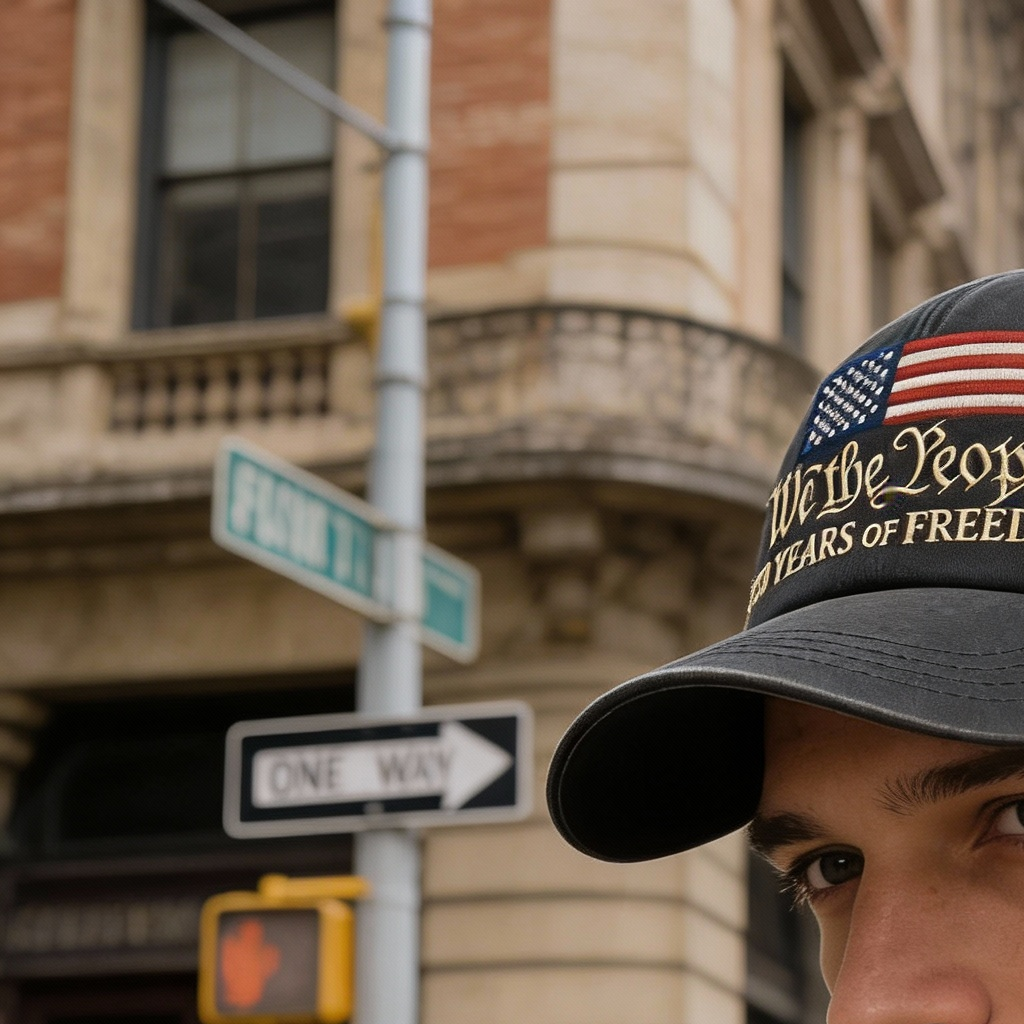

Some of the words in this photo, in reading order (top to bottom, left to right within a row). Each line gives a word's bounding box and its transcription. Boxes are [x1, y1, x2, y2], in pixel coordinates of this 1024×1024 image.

[766, 464, 822, 549] We
[816, 441, 890, 519] the
[774, 521, 856, 585] YEARS
[862, 519, 899, 547] OF
[270, 756, 343, 796] ONE
[374, 750, 454, 786] WAY
